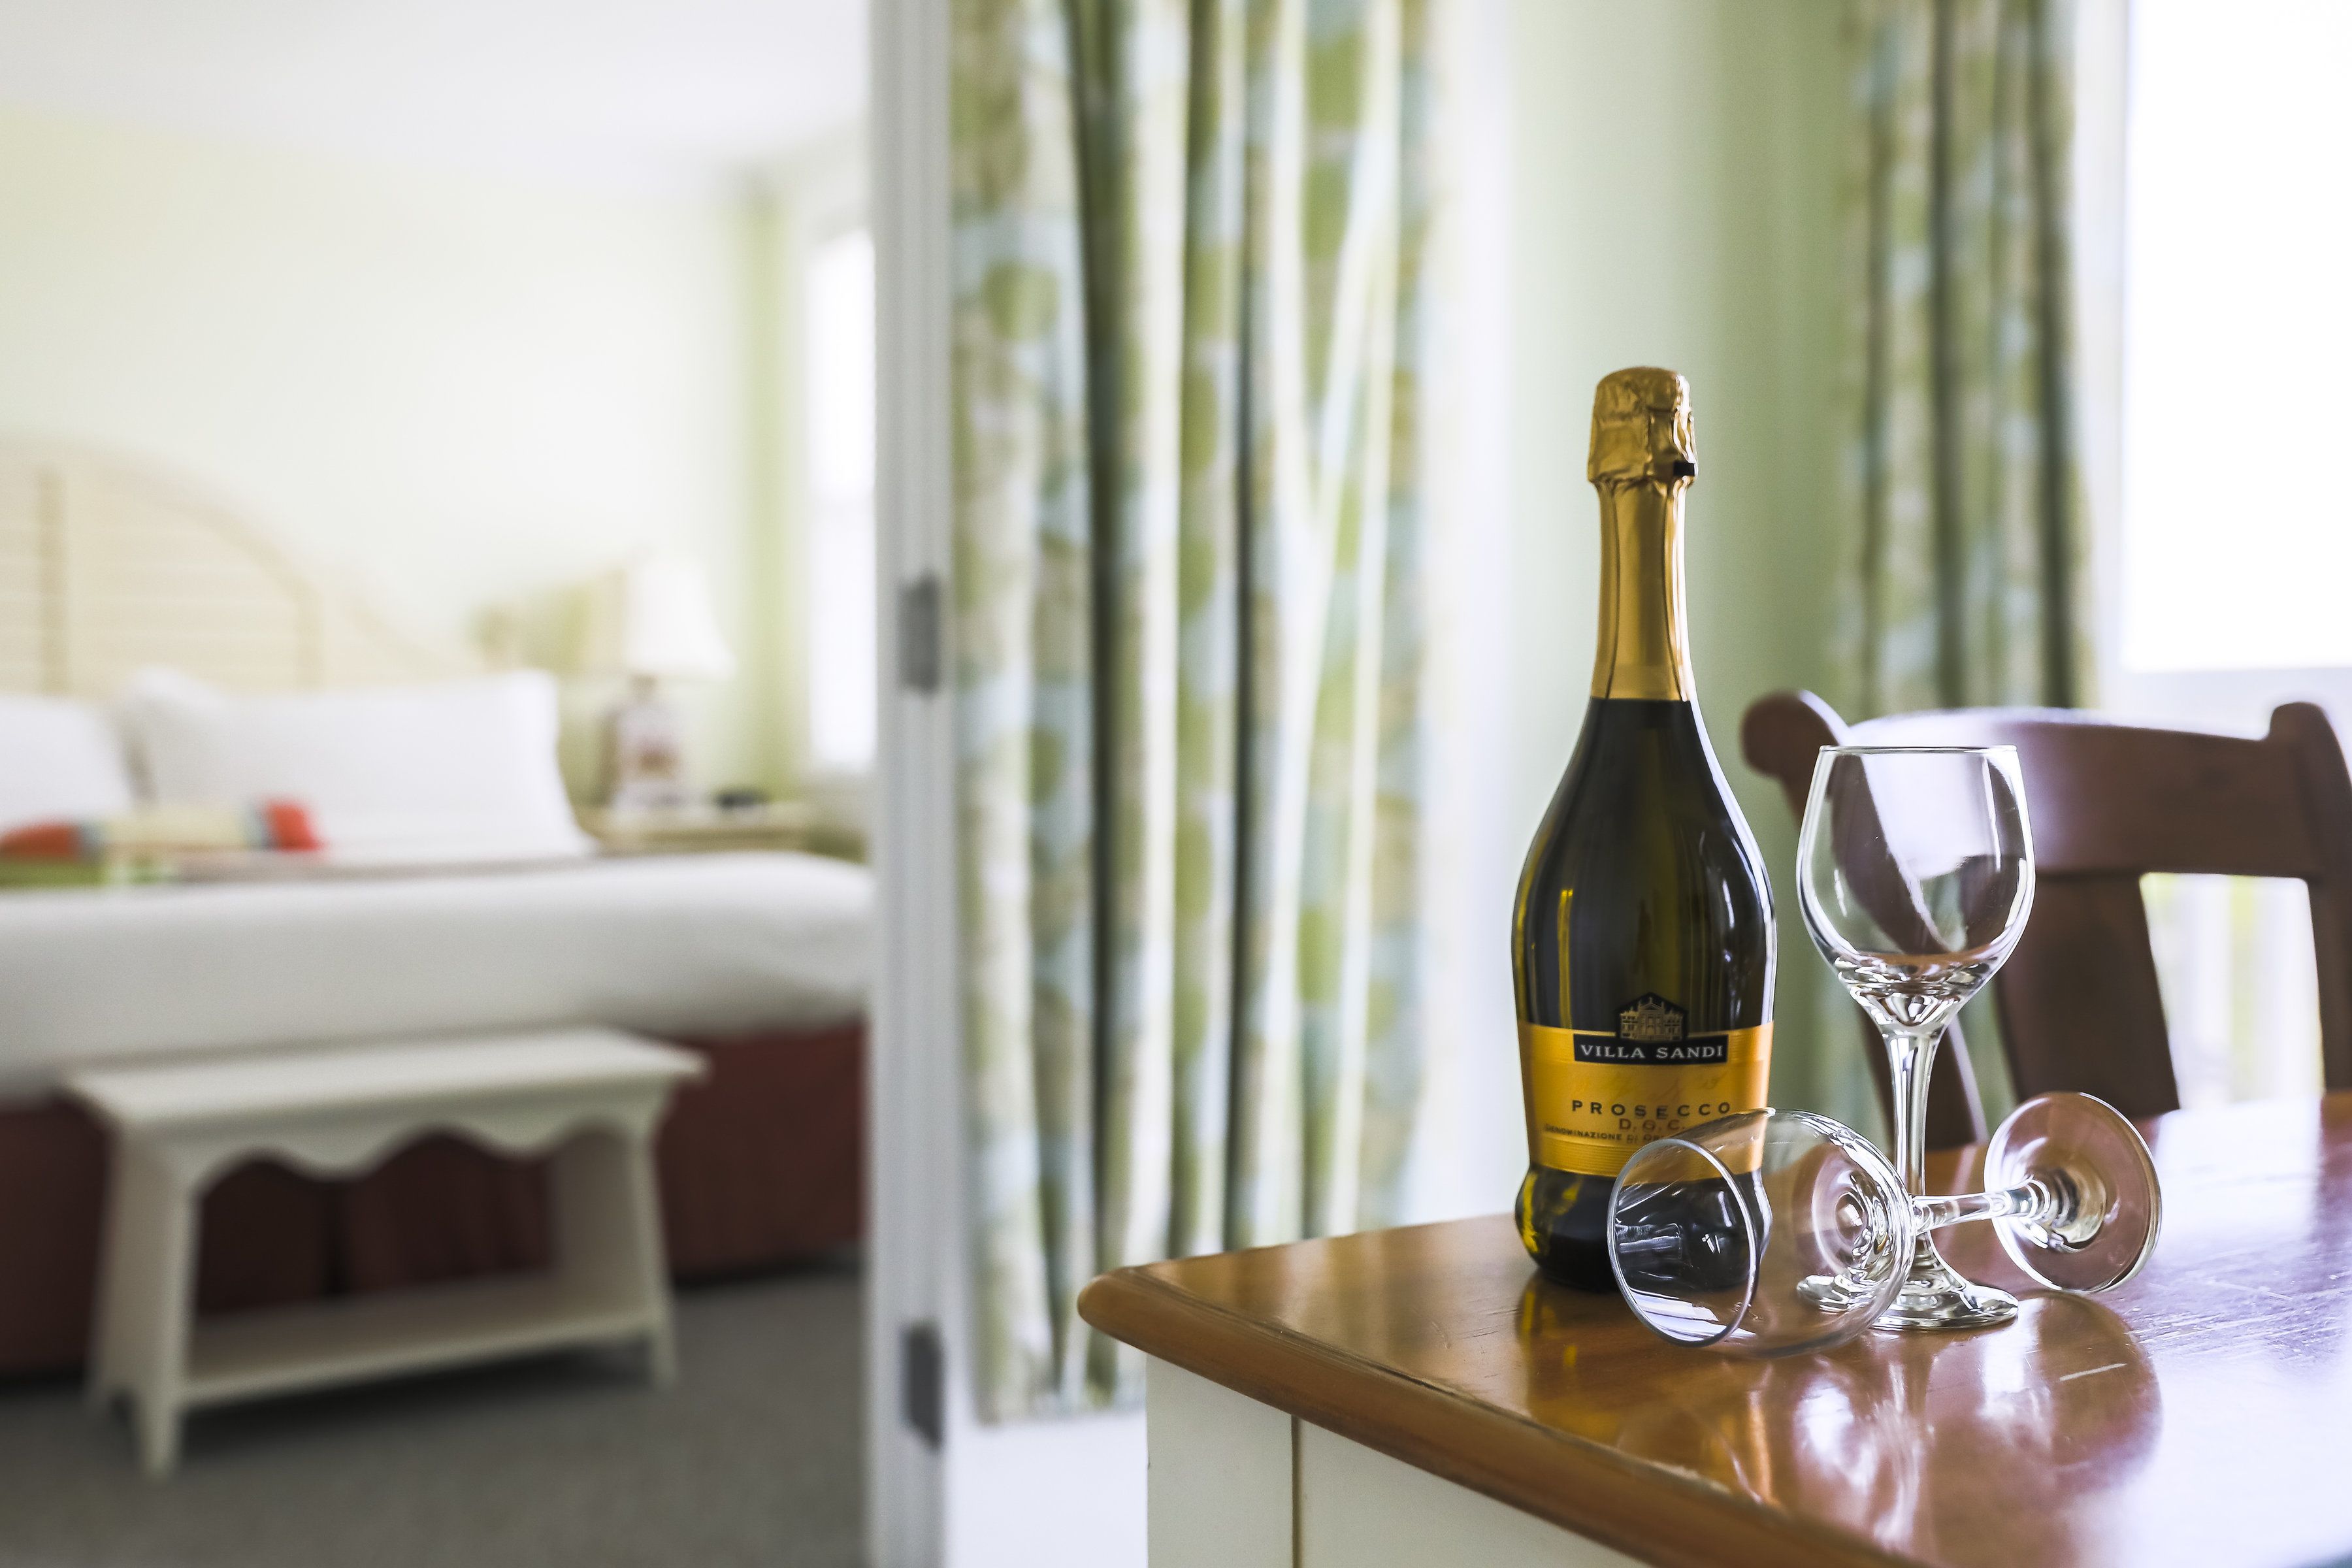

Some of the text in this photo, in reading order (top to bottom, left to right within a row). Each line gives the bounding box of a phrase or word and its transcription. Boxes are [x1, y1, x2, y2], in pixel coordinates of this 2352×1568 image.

[1580, 1044, 1723, 1058] VILLA SANDI
[1571, 1100, 1731, 1119] PROSECCO
